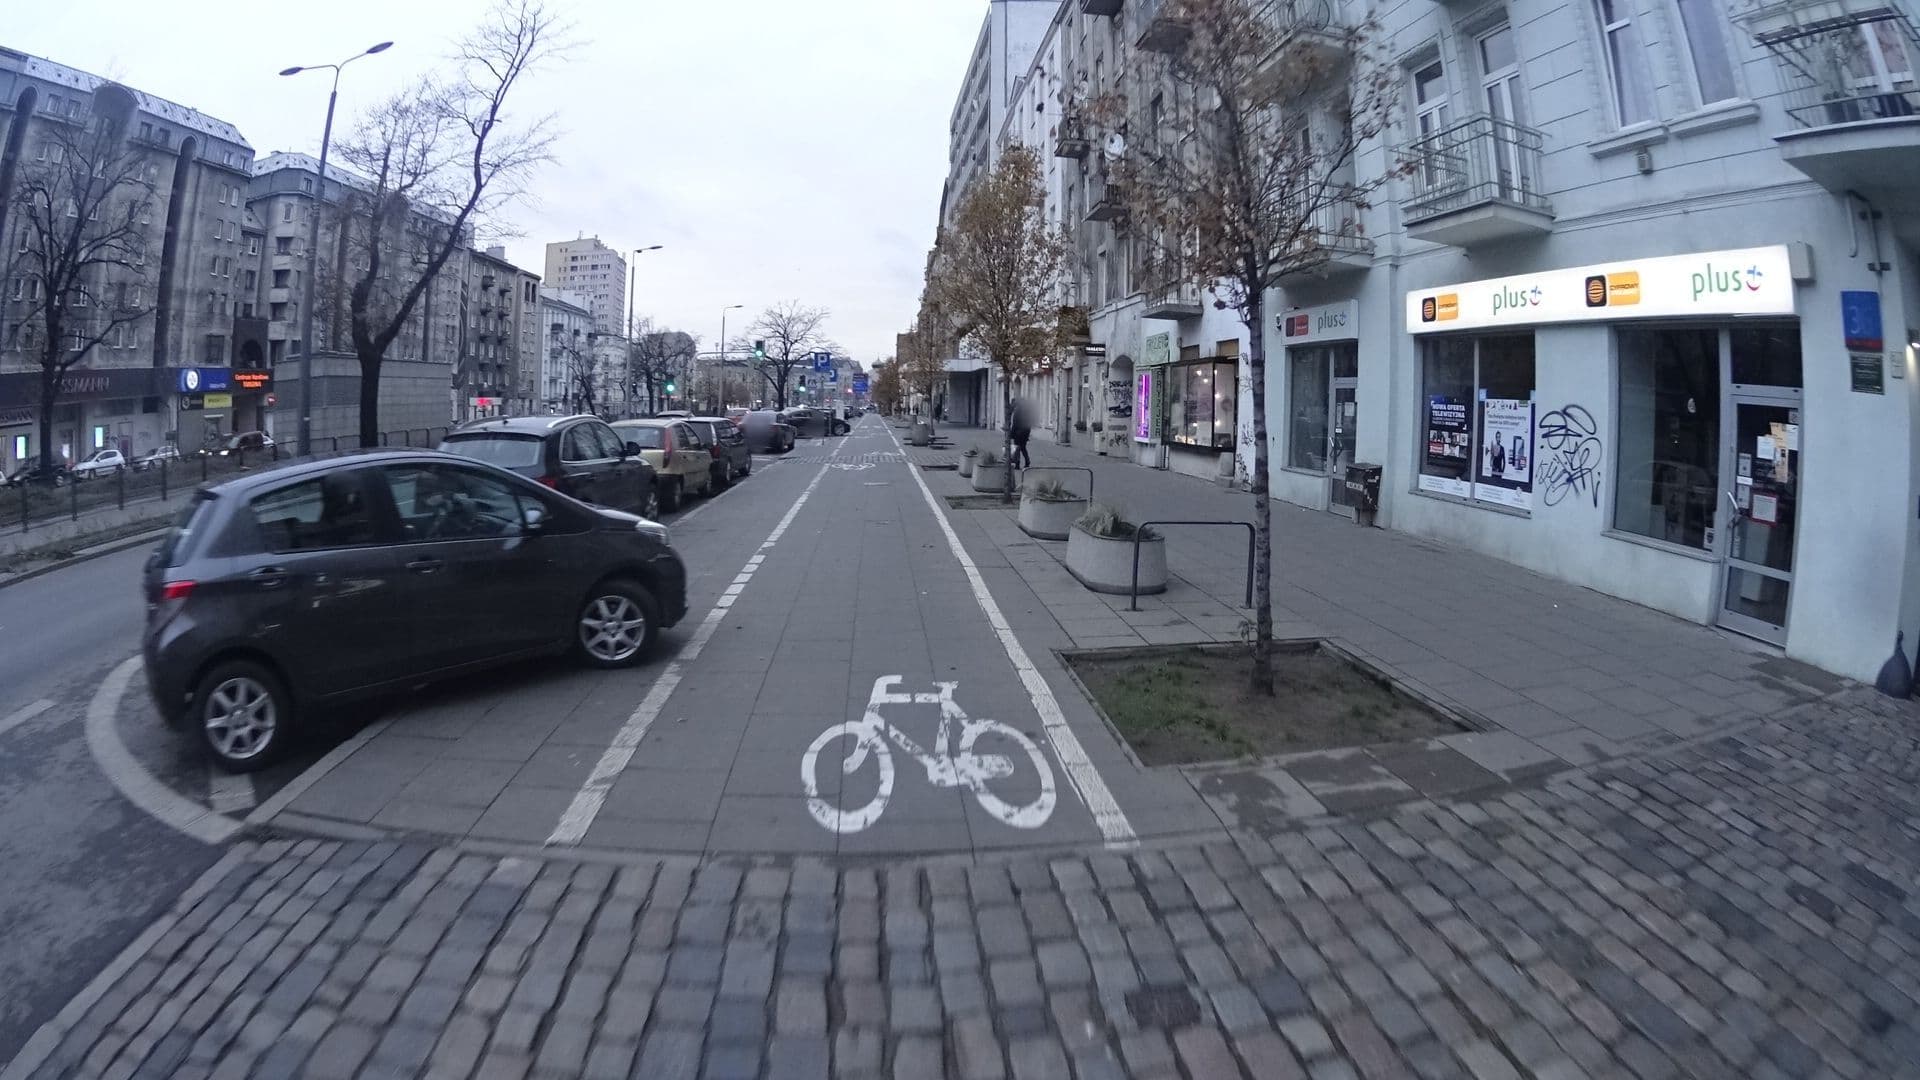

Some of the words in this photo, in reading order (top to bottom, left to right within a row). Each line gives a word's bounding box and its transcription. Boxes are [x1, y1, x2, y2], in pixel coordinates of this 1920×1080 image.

[1692, 263, 1742, 301] plus
[1494, 286, 1527, 315] plus
[1317, 310, 1339, 334] plus
[817, 354, 828, 367] P
[1447, 404, 1465, 412] OFERTA
